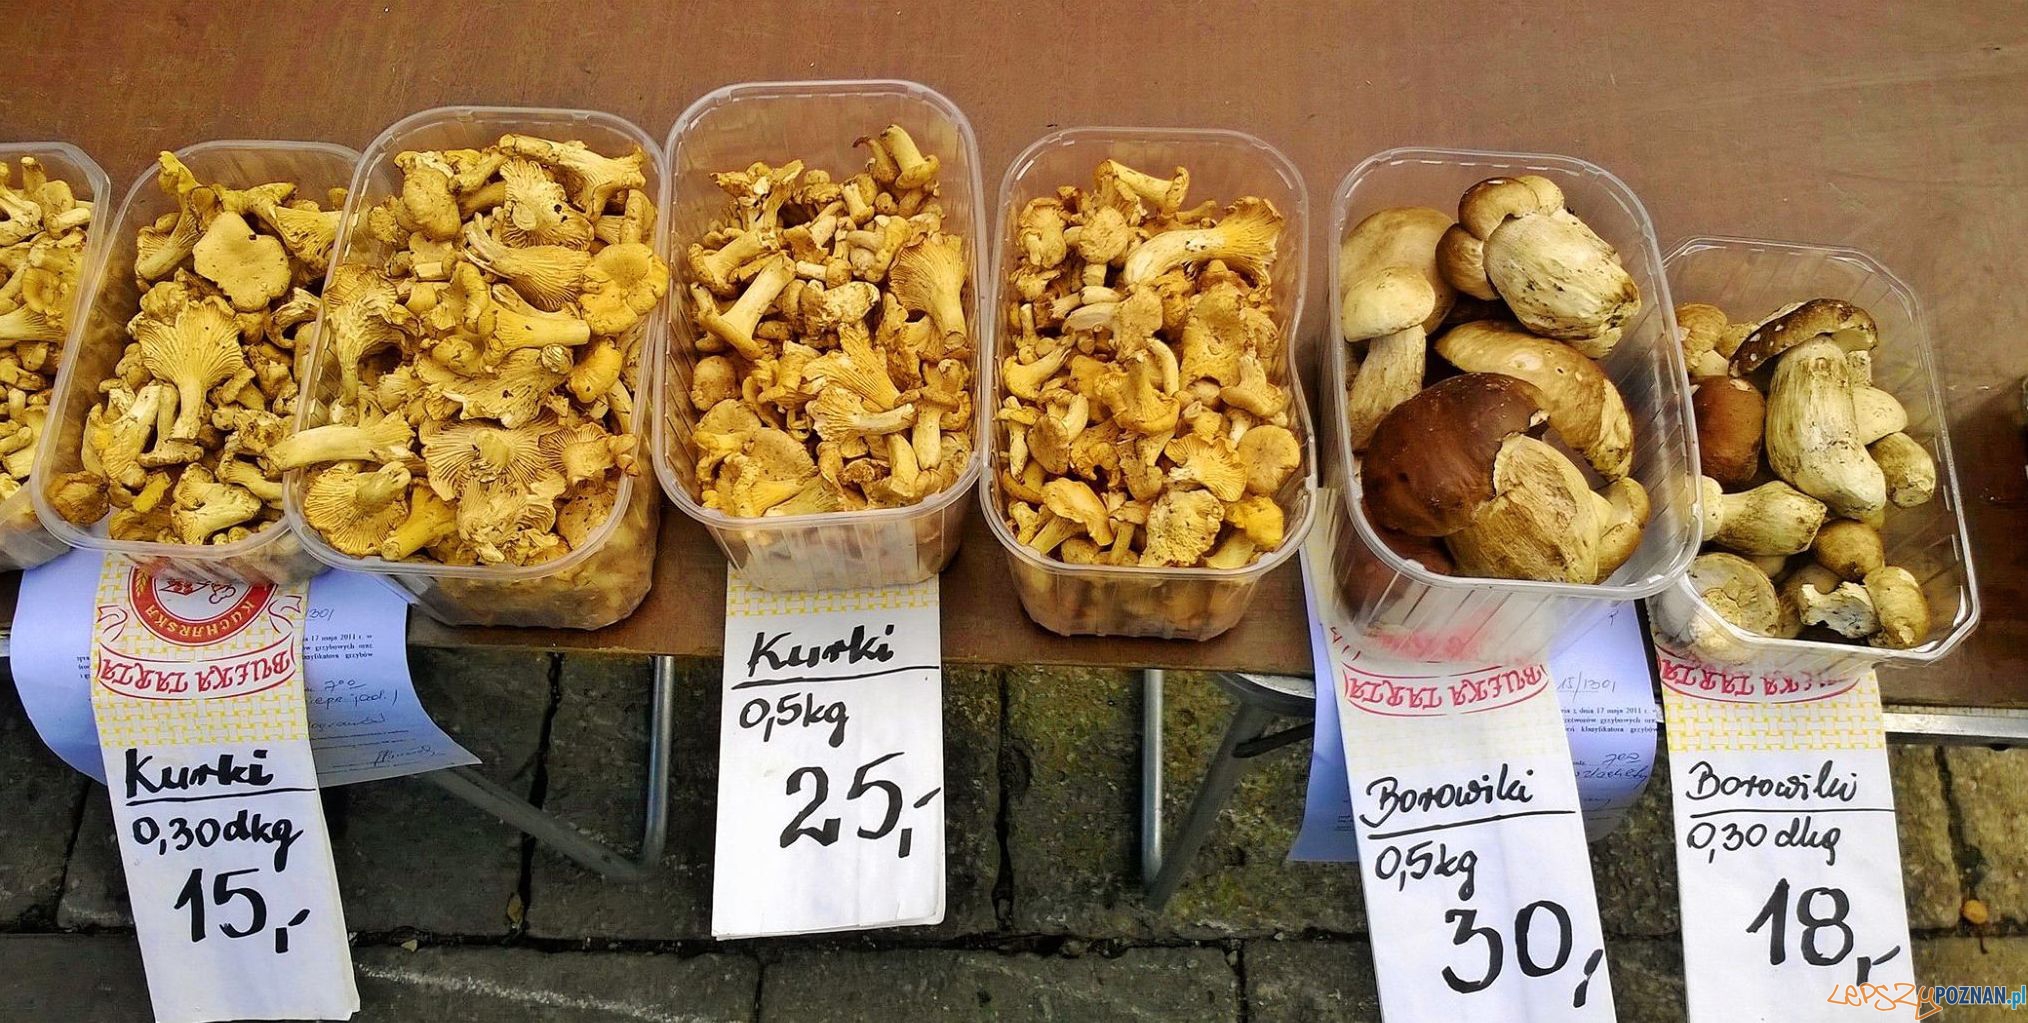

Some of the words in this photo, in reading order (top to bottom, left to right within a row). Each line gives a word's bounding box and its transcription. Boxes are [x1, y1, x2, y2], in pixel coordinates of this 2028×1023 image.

[145, 602, 255, 638] KUCHARSKA
[195, 650, 290, 692] BUŁKA
[748, 624, 895, 678] Kurki
[100, 658, 189, 694] TARTA
[1349, 677, 1443, 710] TARTA
[1447, 665, 1543, 706] BUŁKA
[125, 748, 274, 798] Kurki
[1686, 760, 1857, 802] Borowiki
[1359, 763, 1534, 828] Borowiki
